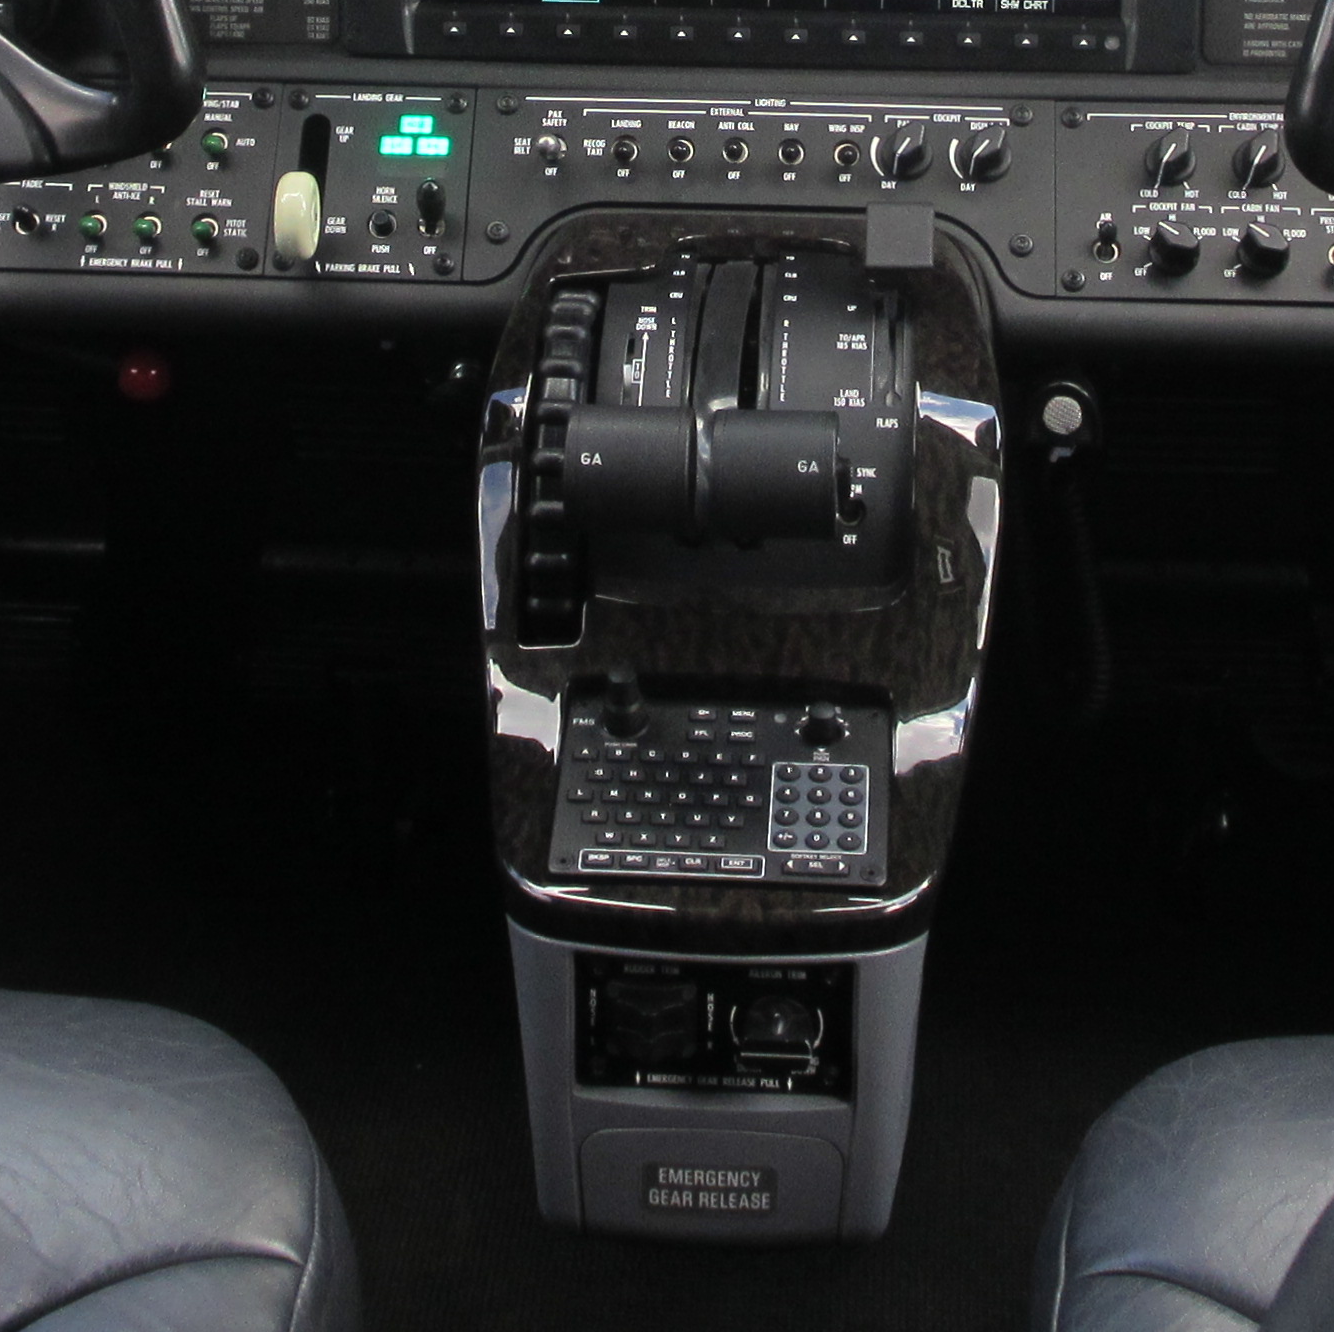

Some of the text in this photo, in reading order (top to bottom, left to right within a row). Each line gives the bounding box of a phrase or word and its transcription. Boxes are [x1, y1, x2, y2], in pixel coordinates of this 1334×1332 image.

[952, 0, 983, 8] DCLTR
[1023, 1, 1048, 9] CHRT
[352, 93, 403, 103] LANDING GEAR
[754, 99, 785, 107] LIGHTING
[710, 108, 744, 117] EXTERNAL
[204, 113, 232, 122] MANUAL
[542, 118, 567, 126] SAFETY
[611, 120, 641, 128] LANDING
[719, 122, 735, 130] ANTI
[336, 127, 354, 135] GEAR
[236, 138, 255, 147] AUTO
[586, 148, 603, 156] TAXI
[22, 180, 43, 188] FADEC
[881, 181, 896, 189] DAY
[376, 187, 395, 195] HORN
[1140, 190, 1158, 198] COLD
[186, 198, 232, 207] STALL WARN
[372, 195, 398, 203] SILENCE
[1150, 203, 1177, 211] COCKPIT
[1242, 204, 1261, 212] CABIN
[1194, 228, 1216, 236] FLOOD
[372, 245, 390, 254] PUSH
[424, 246, 435, 254] OFF
[89, 258, 172, 268] EMERGENCY BRAKE PULL
[325, 263, 400, 272] PARKING BRAKE PULL
[876, 418, 898, 428] FLAPS
[581, 453, 602, 466] GA
[798, 461, 818, 473] GA
[856, 468, 876, 478] SYNC
[843, 535, 857, 544] OFF
[659, 1168, 760, 1187] EMERGENCY
[650, 1189, 770, 1209] GEAR RELEASE
